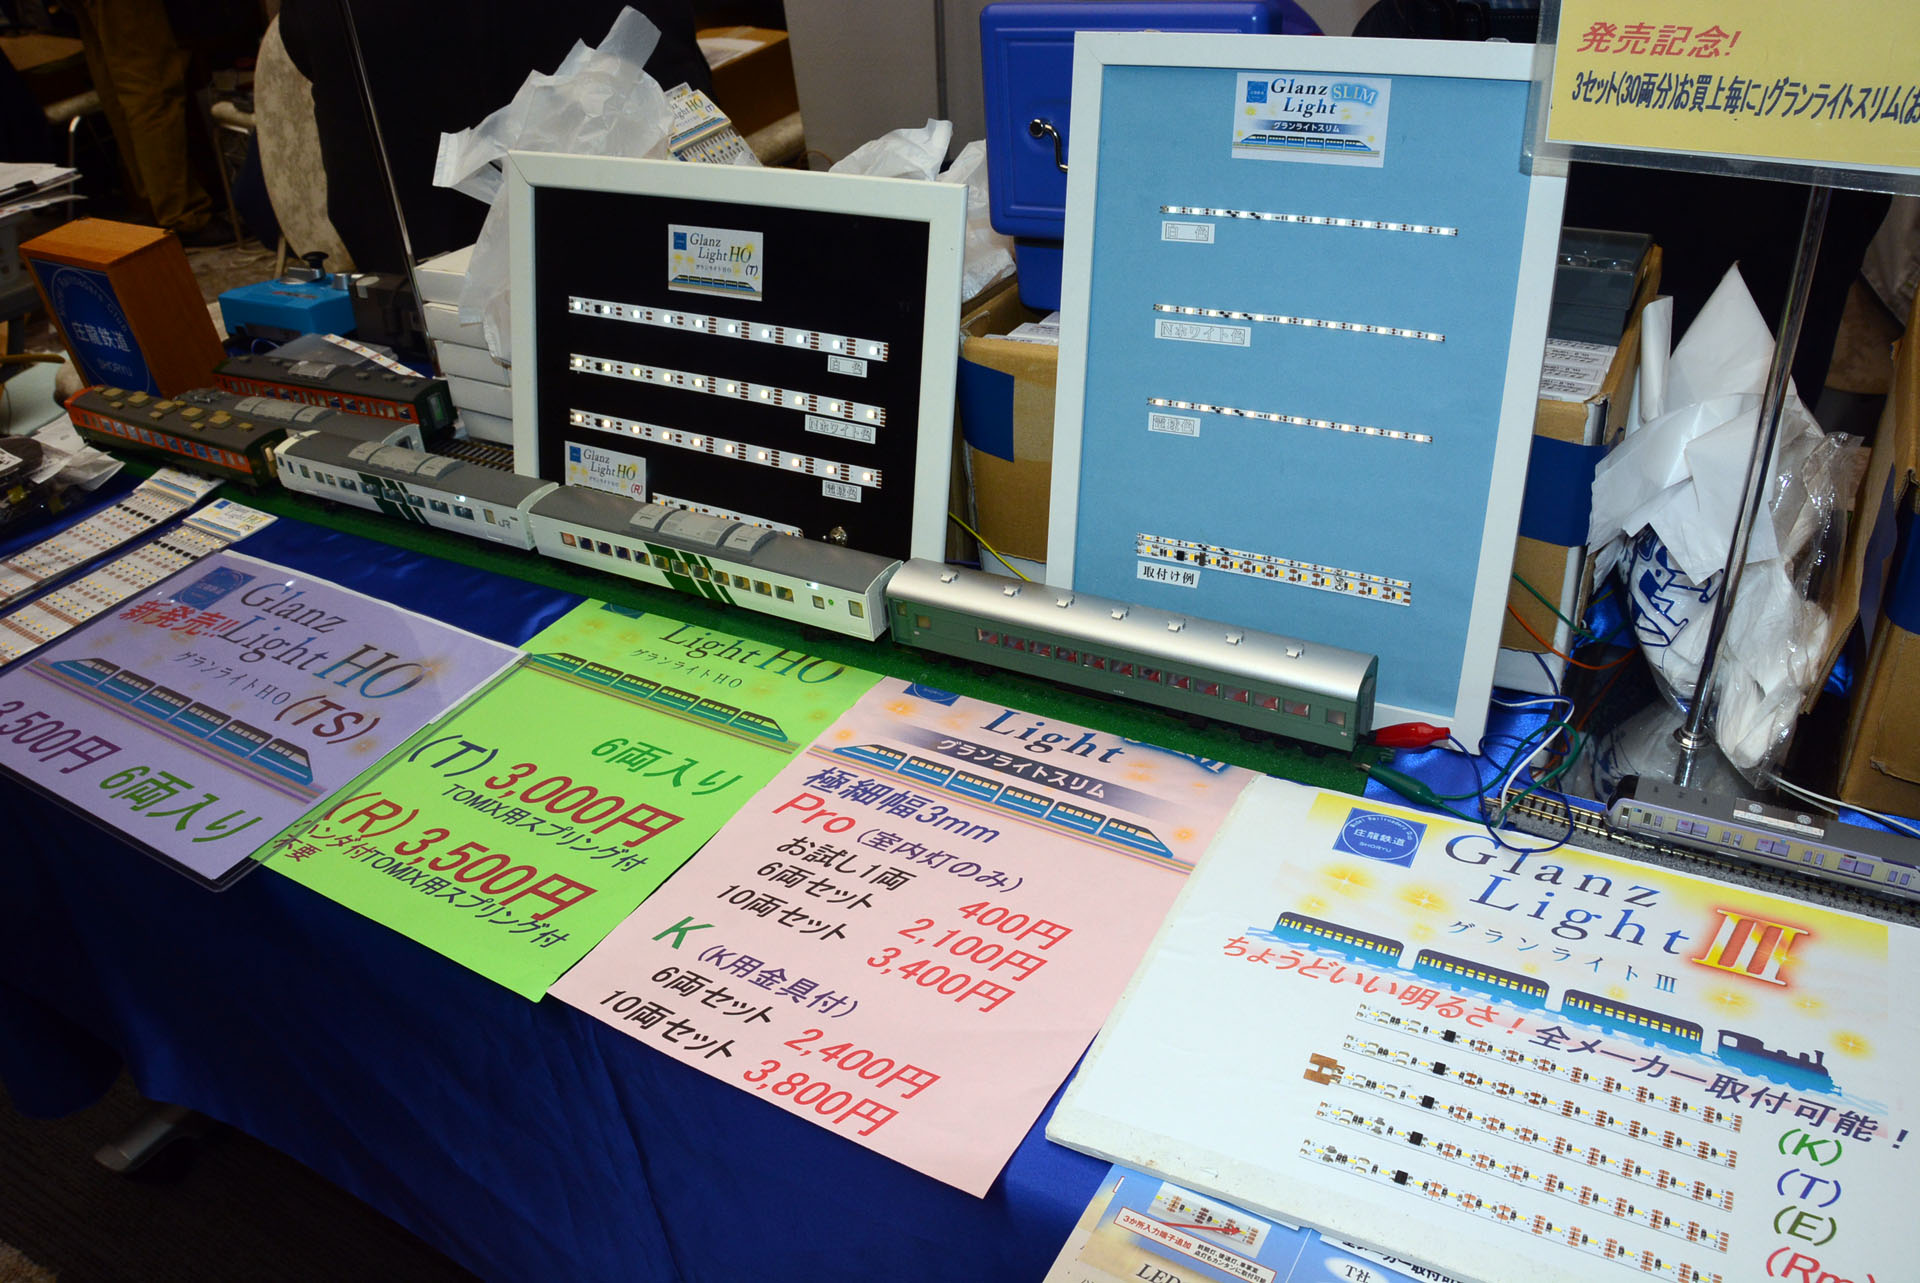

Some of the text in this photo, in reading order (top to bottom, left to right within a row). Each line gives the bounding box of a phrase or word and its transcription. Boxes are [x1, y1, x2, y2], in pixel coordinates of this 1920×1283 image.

[1576, 21, 1742, 58] 発売記念!
[1270, 77, 1328, 96] Glanz
[1333, 85, 1376, 105] SLIM
[1283, 97, 1337, 118] Light
[1273, 121, 1340, 133] グランライトスリム
[689, 233, 721, 247] Glanz
[698, 246, 751, 263] Light HO
[745, 264, 758, 276] (T)
[583, 449, 610, 464] Glanz
[591, 462, 636, 480] Light HO
[631, 484, 643, 496] (R)
[1143, 565, 1194, 585] 取付け例
[241, 582, 347, 633] Glanz
[217, 615, 425, 699] Light HO
[659, 623, 847, 684] Light HO
[274, 695, 380, 745] (TS)
[980, 709, 1125, 764] Light
[408, 734, 685, 849] (T) 3,000円
[591, 737, 743, 796] 6両入り
[937, 739, 1104, 798] グランライトスリム
[99, 765, 263, 843] 6両入り
[441, 783, 649, 873] TOMIX用スプリング付
[800, 766, 1001, 844] 極細幅3mm
[273, 834, 322, 862] 不要
[323, 792, 598, 921] (R) 3,500円
[772, 792, 1025, 894] Pro (室内灯のみ)
[1445, 834, 1661, 907] Glanz
[361, 849, 570, 949] TOMIX用スプリング付
[757, 861, 1048, 982] 6両セット 2,100円
[776, 836, 1073, 951] お試し1両 400円
[1469, 874, 1690, 955] Light
[652, 915, 858, 1018] K (K用金具付)
[717, 884, 1016, 1013] 10両セット 3,400円
[651, 966, 941, 1099] 6両セット 2,400円
[1223, 936, 1908, 1149] ちょうどいい明るさ！ 全メーカー取付可能！
[599, 990, 900, 1137] 10両セット 3,800円
[1778, 1128, 1842, 1166] (K)
[1777, 1168, 1841, 1208] (T)
[1773, 1205, 1837, 1247] (E)
